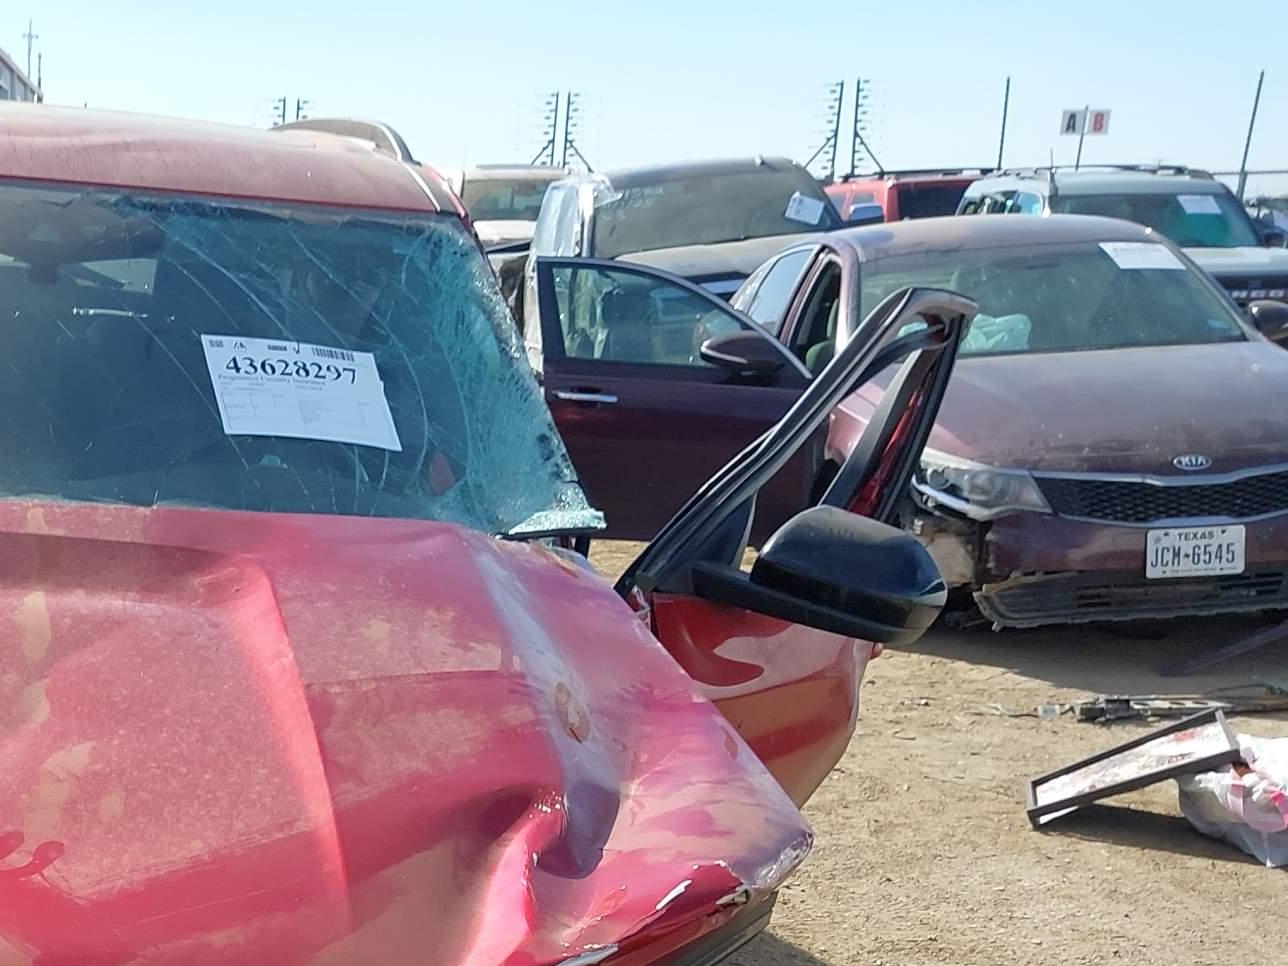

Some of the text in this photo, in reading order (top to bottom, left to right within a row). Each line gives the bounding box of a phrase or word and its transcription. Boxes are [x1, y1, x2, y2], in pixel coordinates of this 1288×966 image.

[1065, 112, 1076, 132] A
[225, 355, 357, 385] 43628297
[1180, 455, 1207, 466] KIA
[1177, 531, 1214, 542] TEXAS
